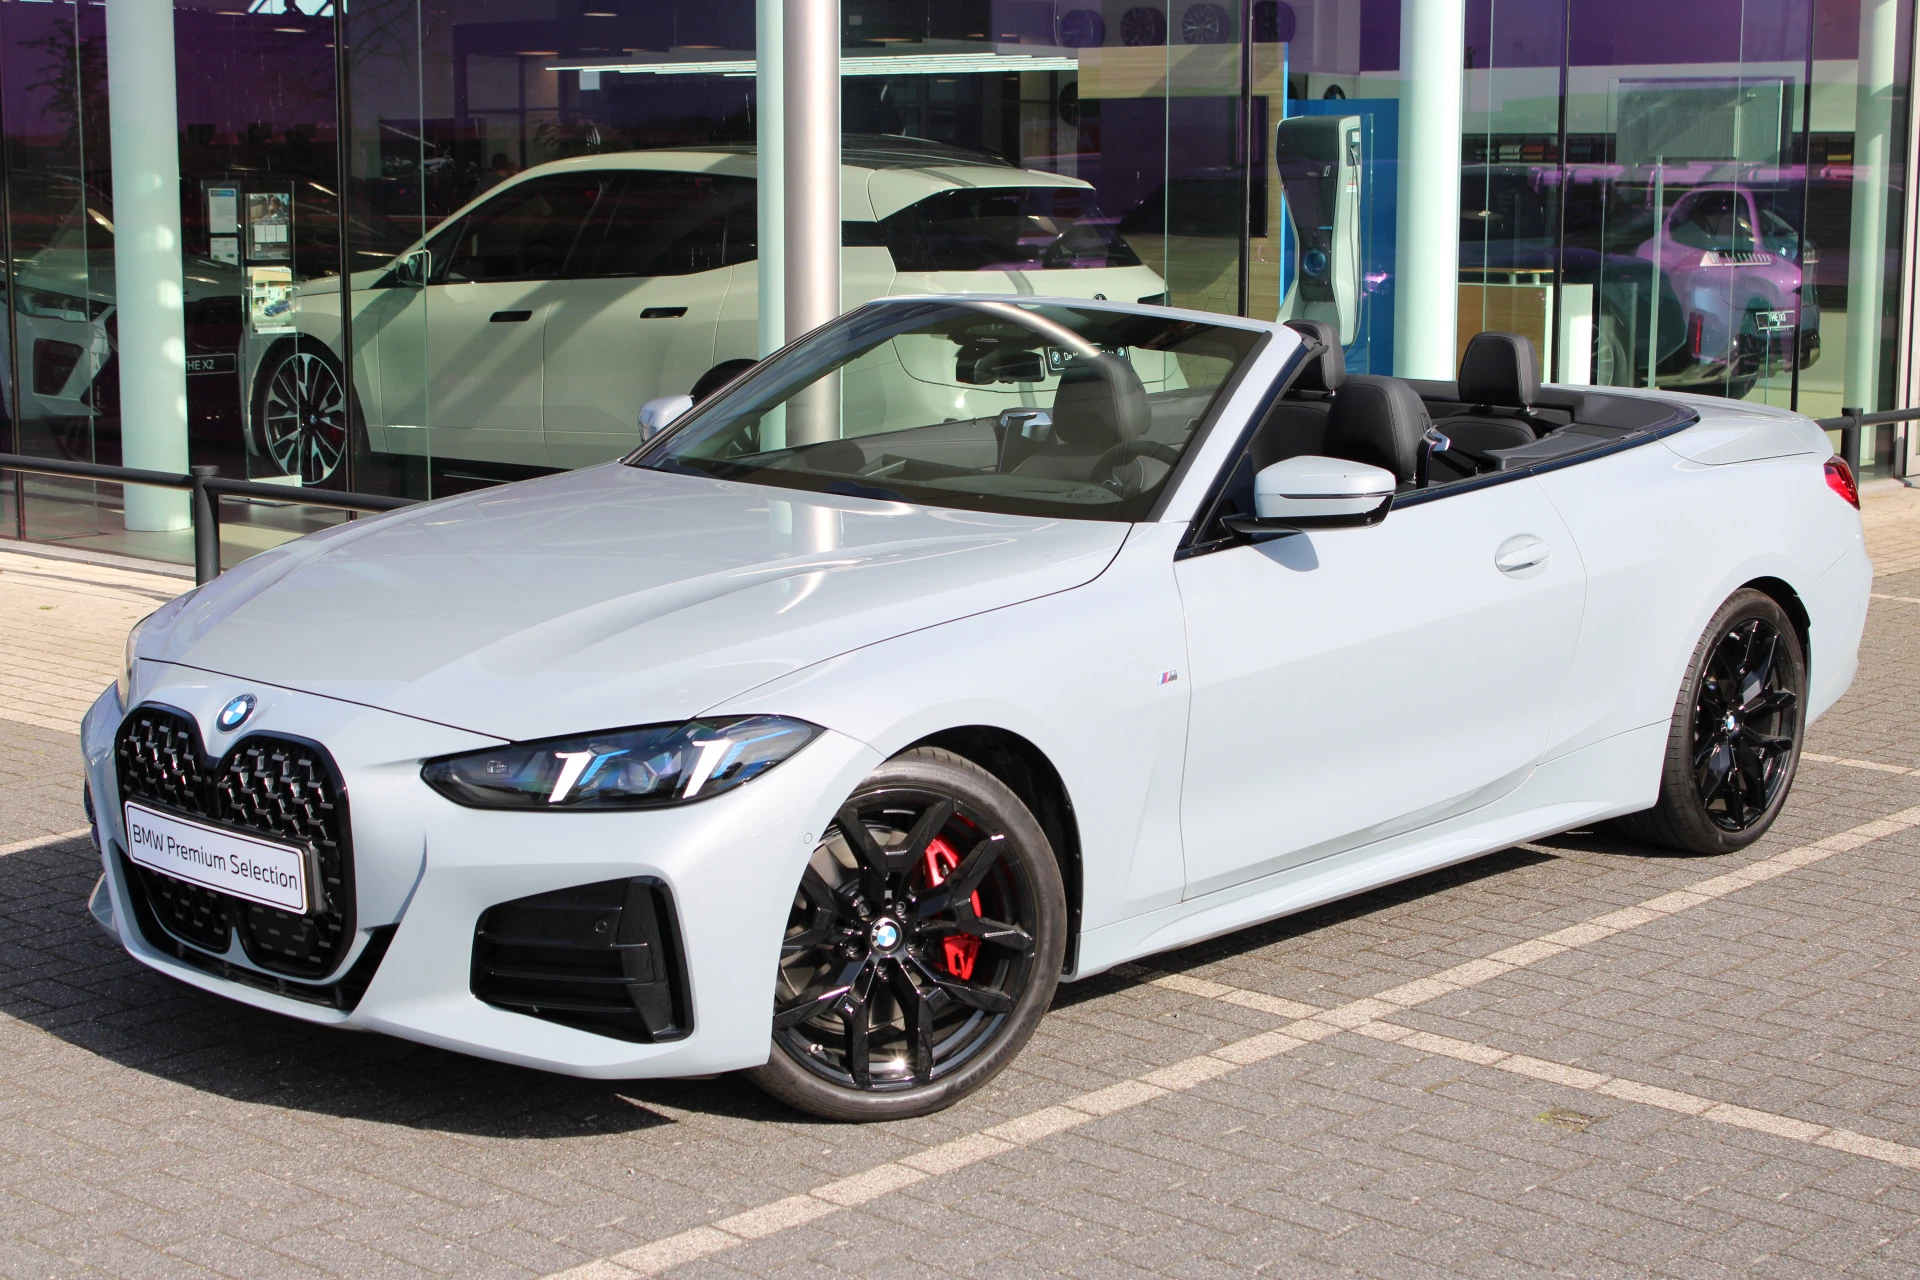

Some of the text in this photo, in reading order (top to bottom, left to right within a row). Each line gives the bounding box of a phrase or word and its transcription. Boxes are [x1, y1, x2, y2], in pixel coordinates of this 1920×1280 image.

[186, 359, 215, 371] HE X2
[132, 824, 298, 890] BMW Premium Selection
